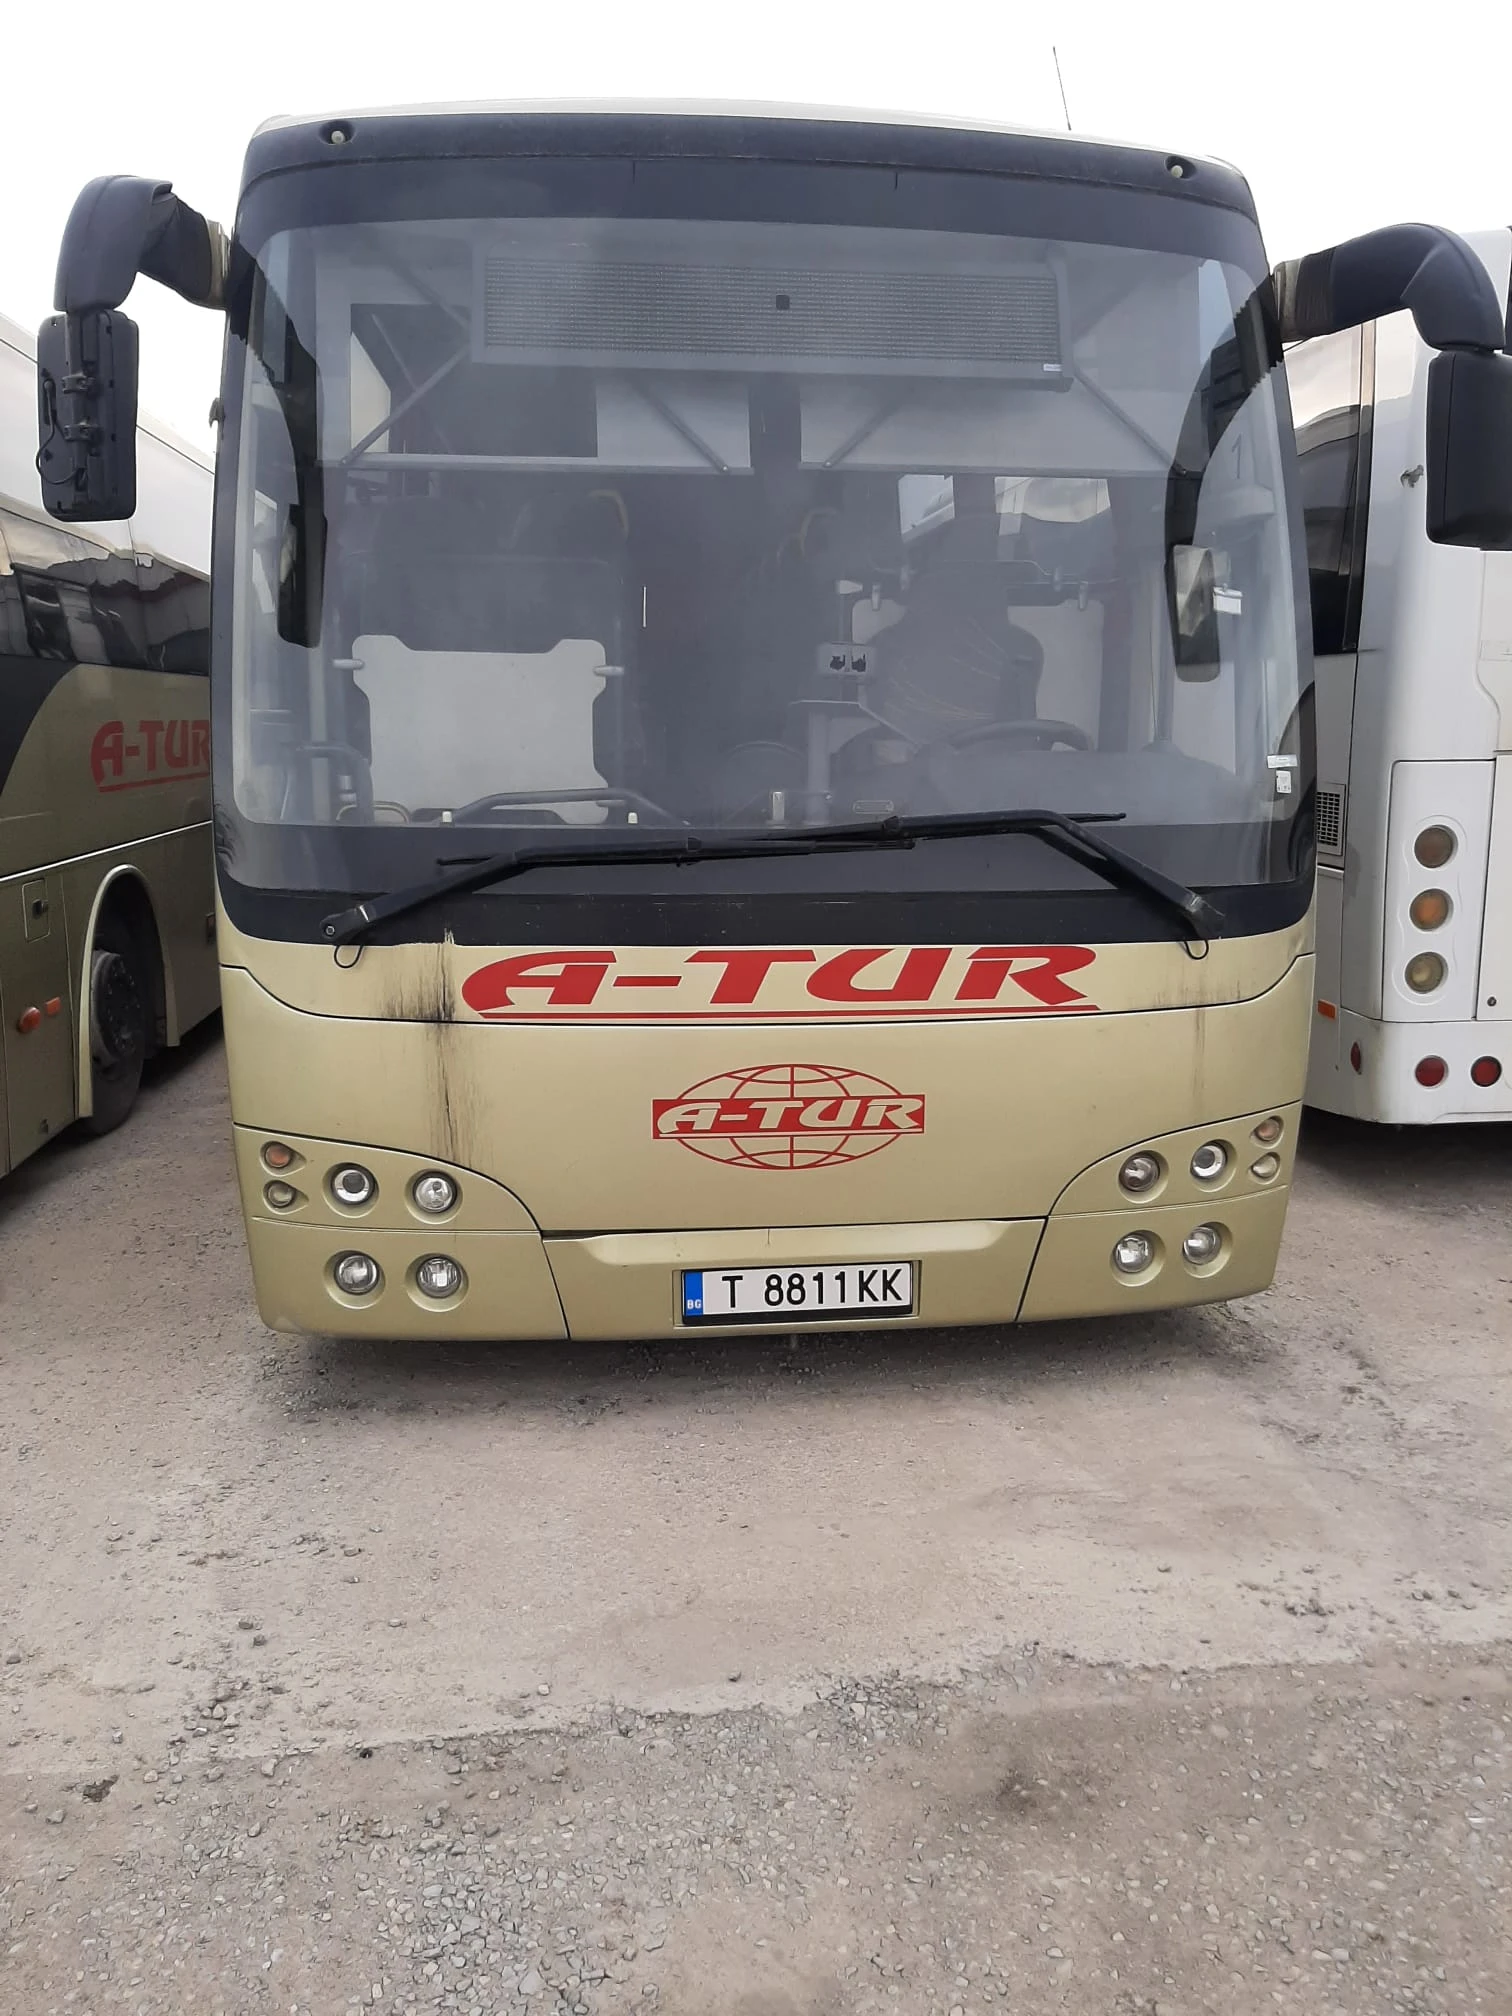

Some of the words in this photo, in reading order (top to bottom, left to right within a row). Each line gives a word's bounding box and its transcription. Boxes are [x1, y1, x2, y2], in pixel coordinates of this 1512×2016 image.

[90, 720, 210, 786] A-TUR
[462, 945, 1098, 1011] A-TUR
[657, 1098, 924, 1134] A-TUR
[686, 1299, 702, 1310] BG
